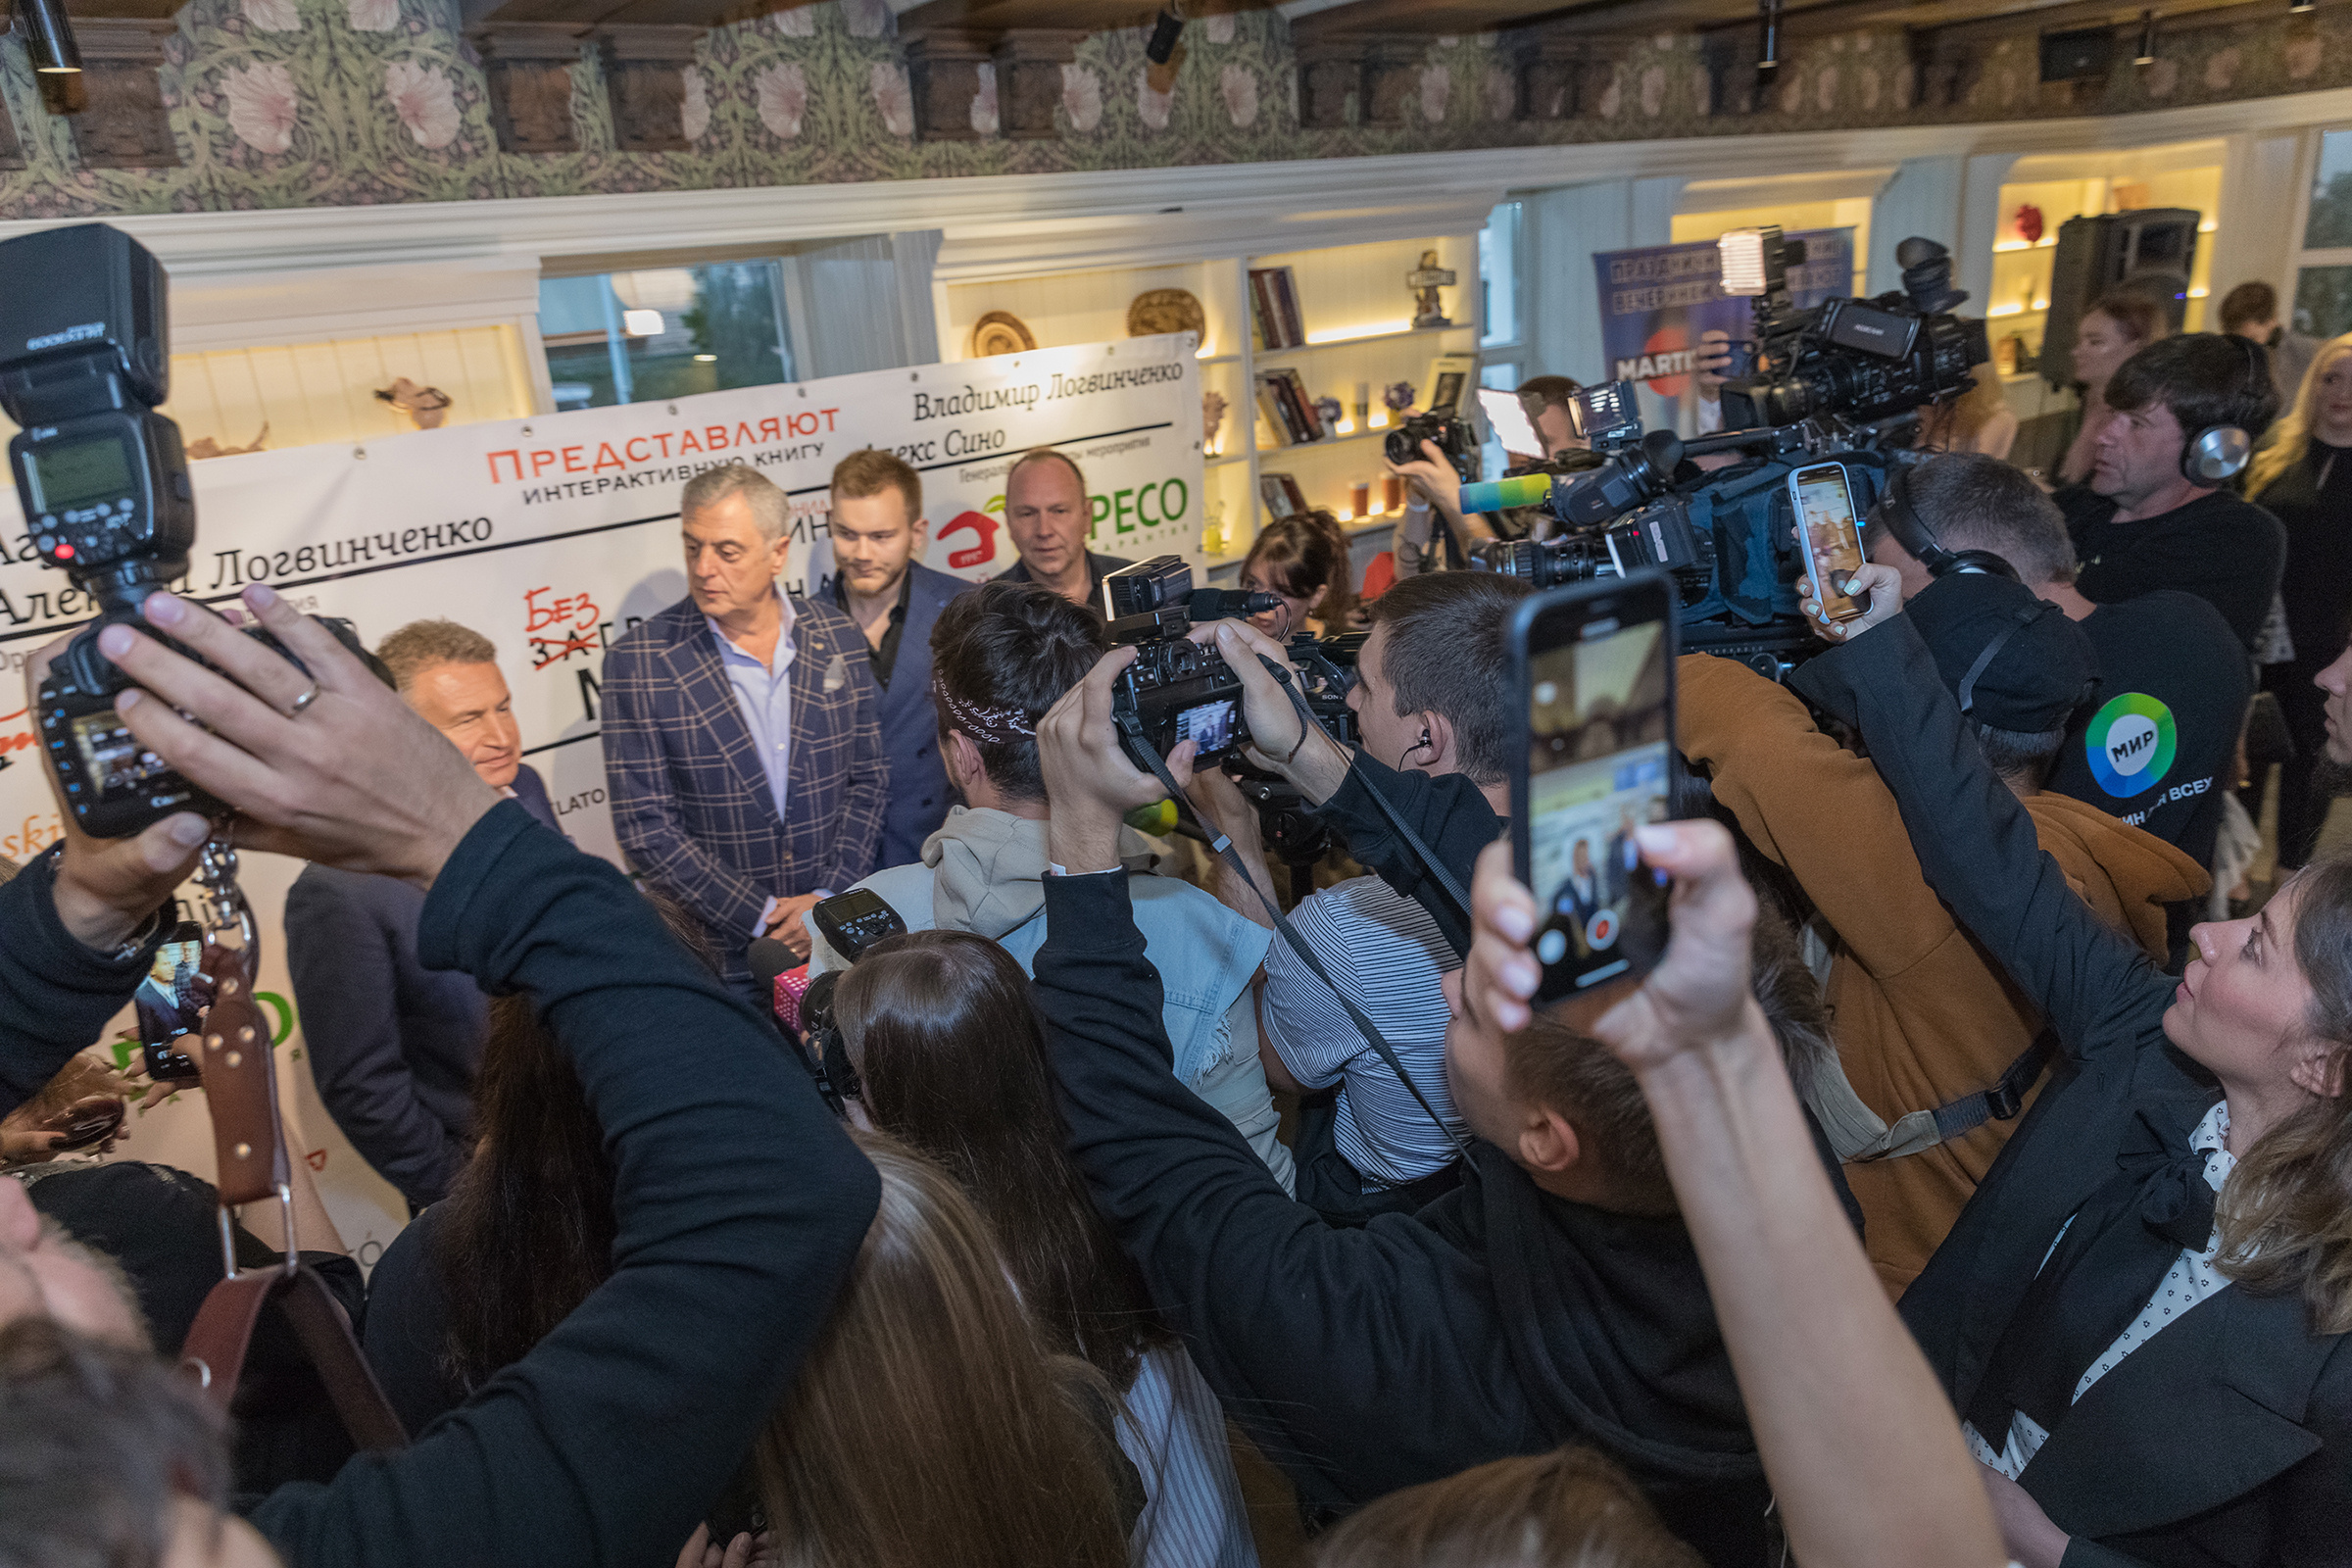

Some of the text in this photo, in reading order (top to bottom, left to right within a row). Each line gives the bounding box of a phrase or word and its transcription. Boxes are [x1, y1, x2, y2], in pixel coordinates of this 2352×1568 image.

[1617, 351, 1696, 382] MARTI
[913, 361, 1183, 421] Владимир Логвинченко
[486, 408, 841, 484] ПРЕДСТАВЛЯЮТ
[754, 442, 825, 467] КНИГУ
[945, 428, 1005, 457] Сино
[211, 516, 495, 589] Логвинченко
[2111, 730, 2154, 762] МИР
